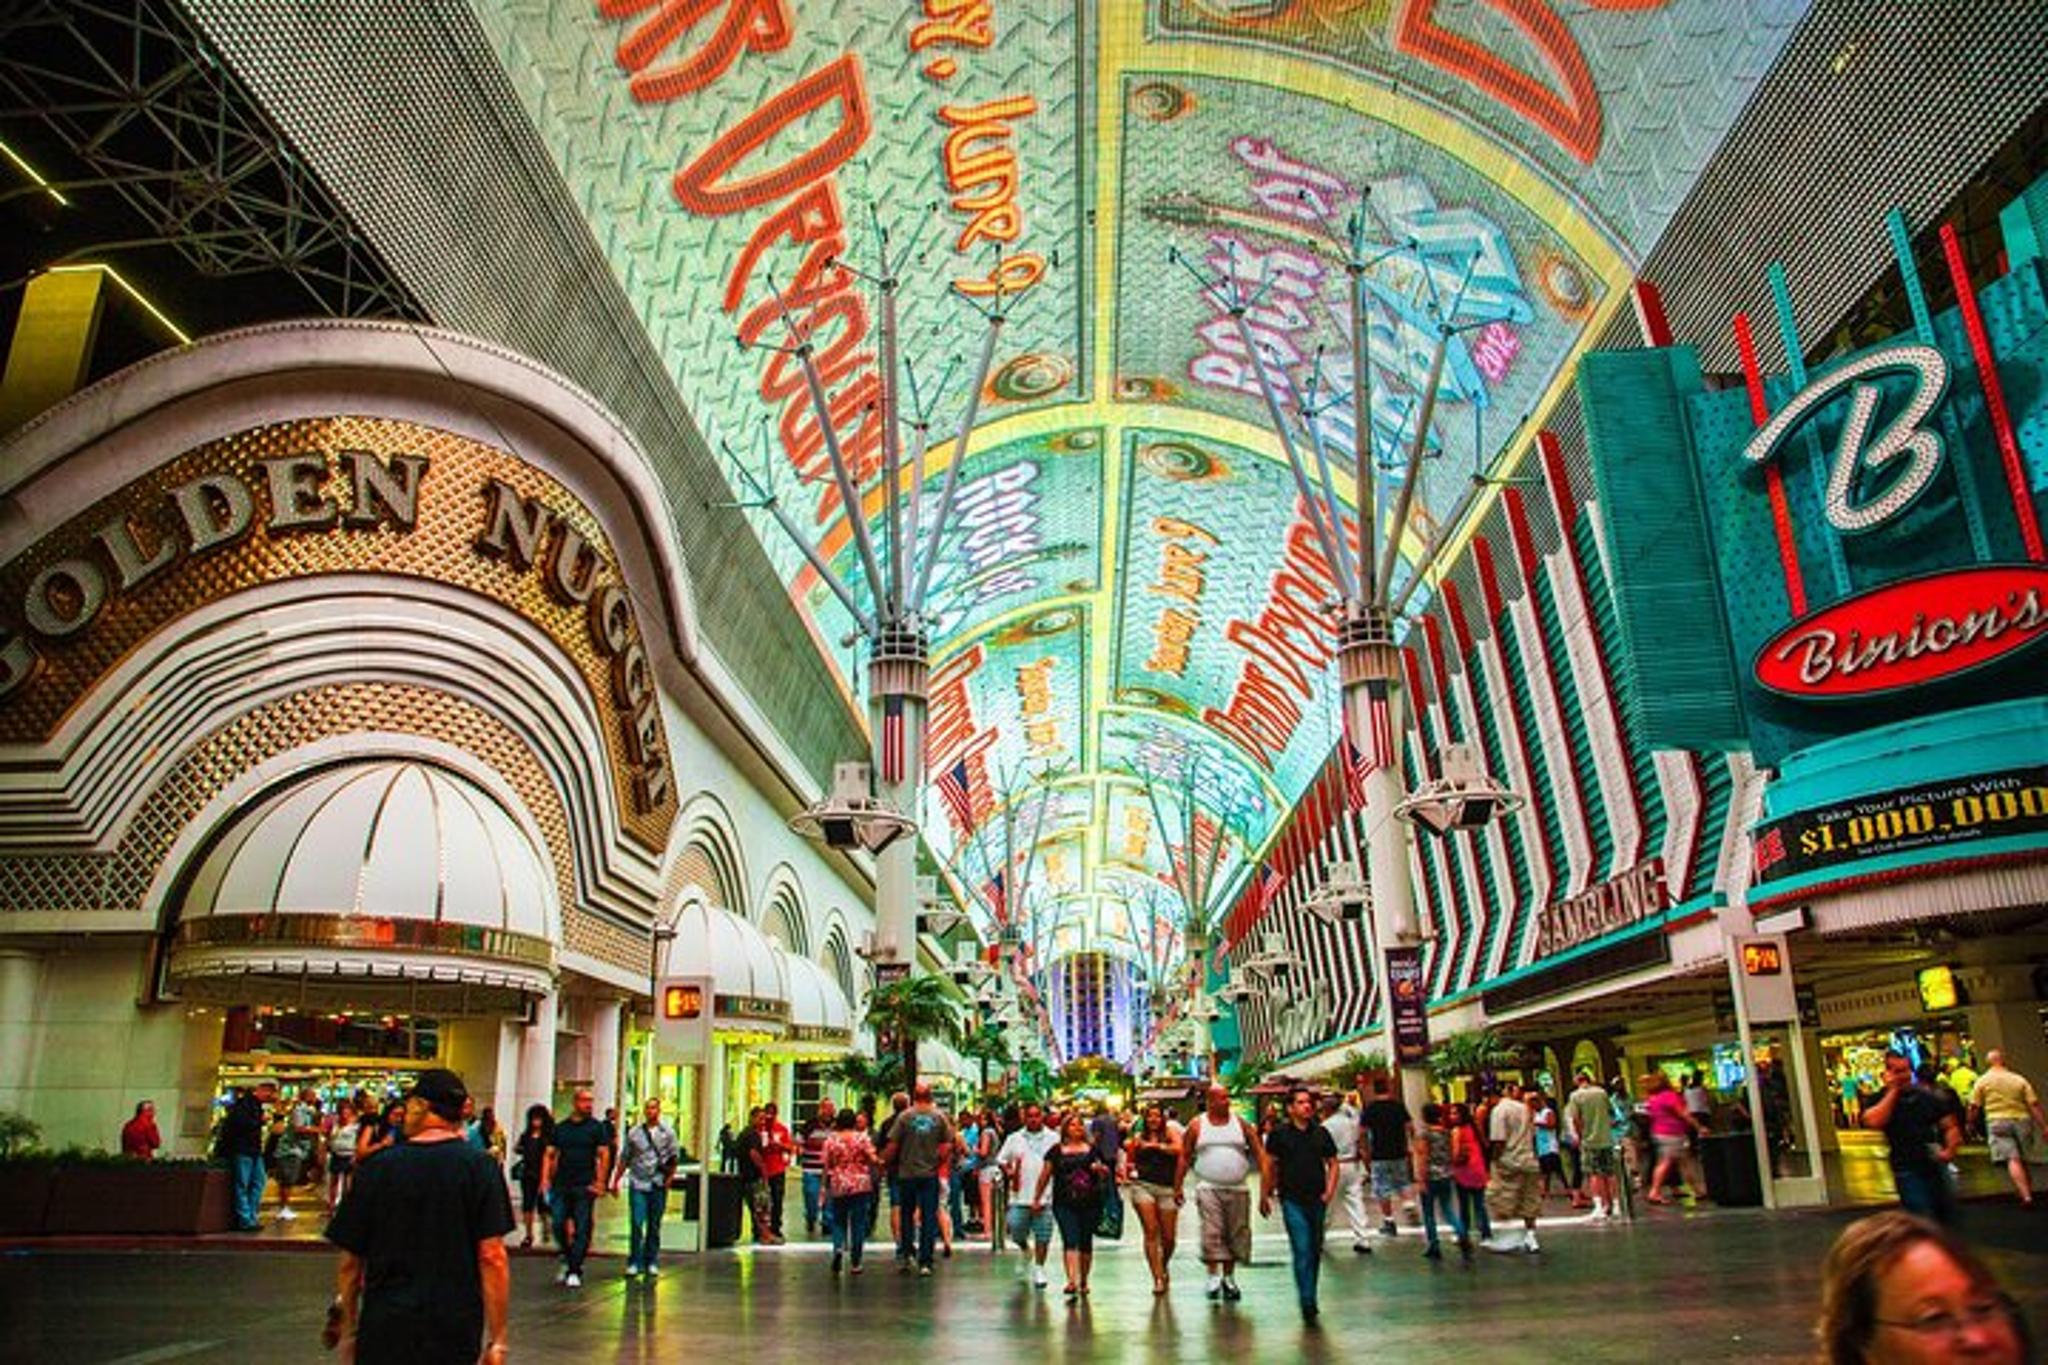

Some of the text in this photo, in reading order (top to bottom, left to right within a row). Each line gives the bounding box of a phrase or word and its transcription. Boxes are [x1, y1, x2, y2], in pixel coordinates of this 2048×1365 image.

[938, 95, 1038, 252] June
[1475, 320, 1523, 384] 2012
[1742, 345, 1949, 534] B
[472, 478, 668, 818] NUGGET
[1776, 588, 2048, 684] Binion's
[1816, 776, 2023, 825] Take Your Picture With
